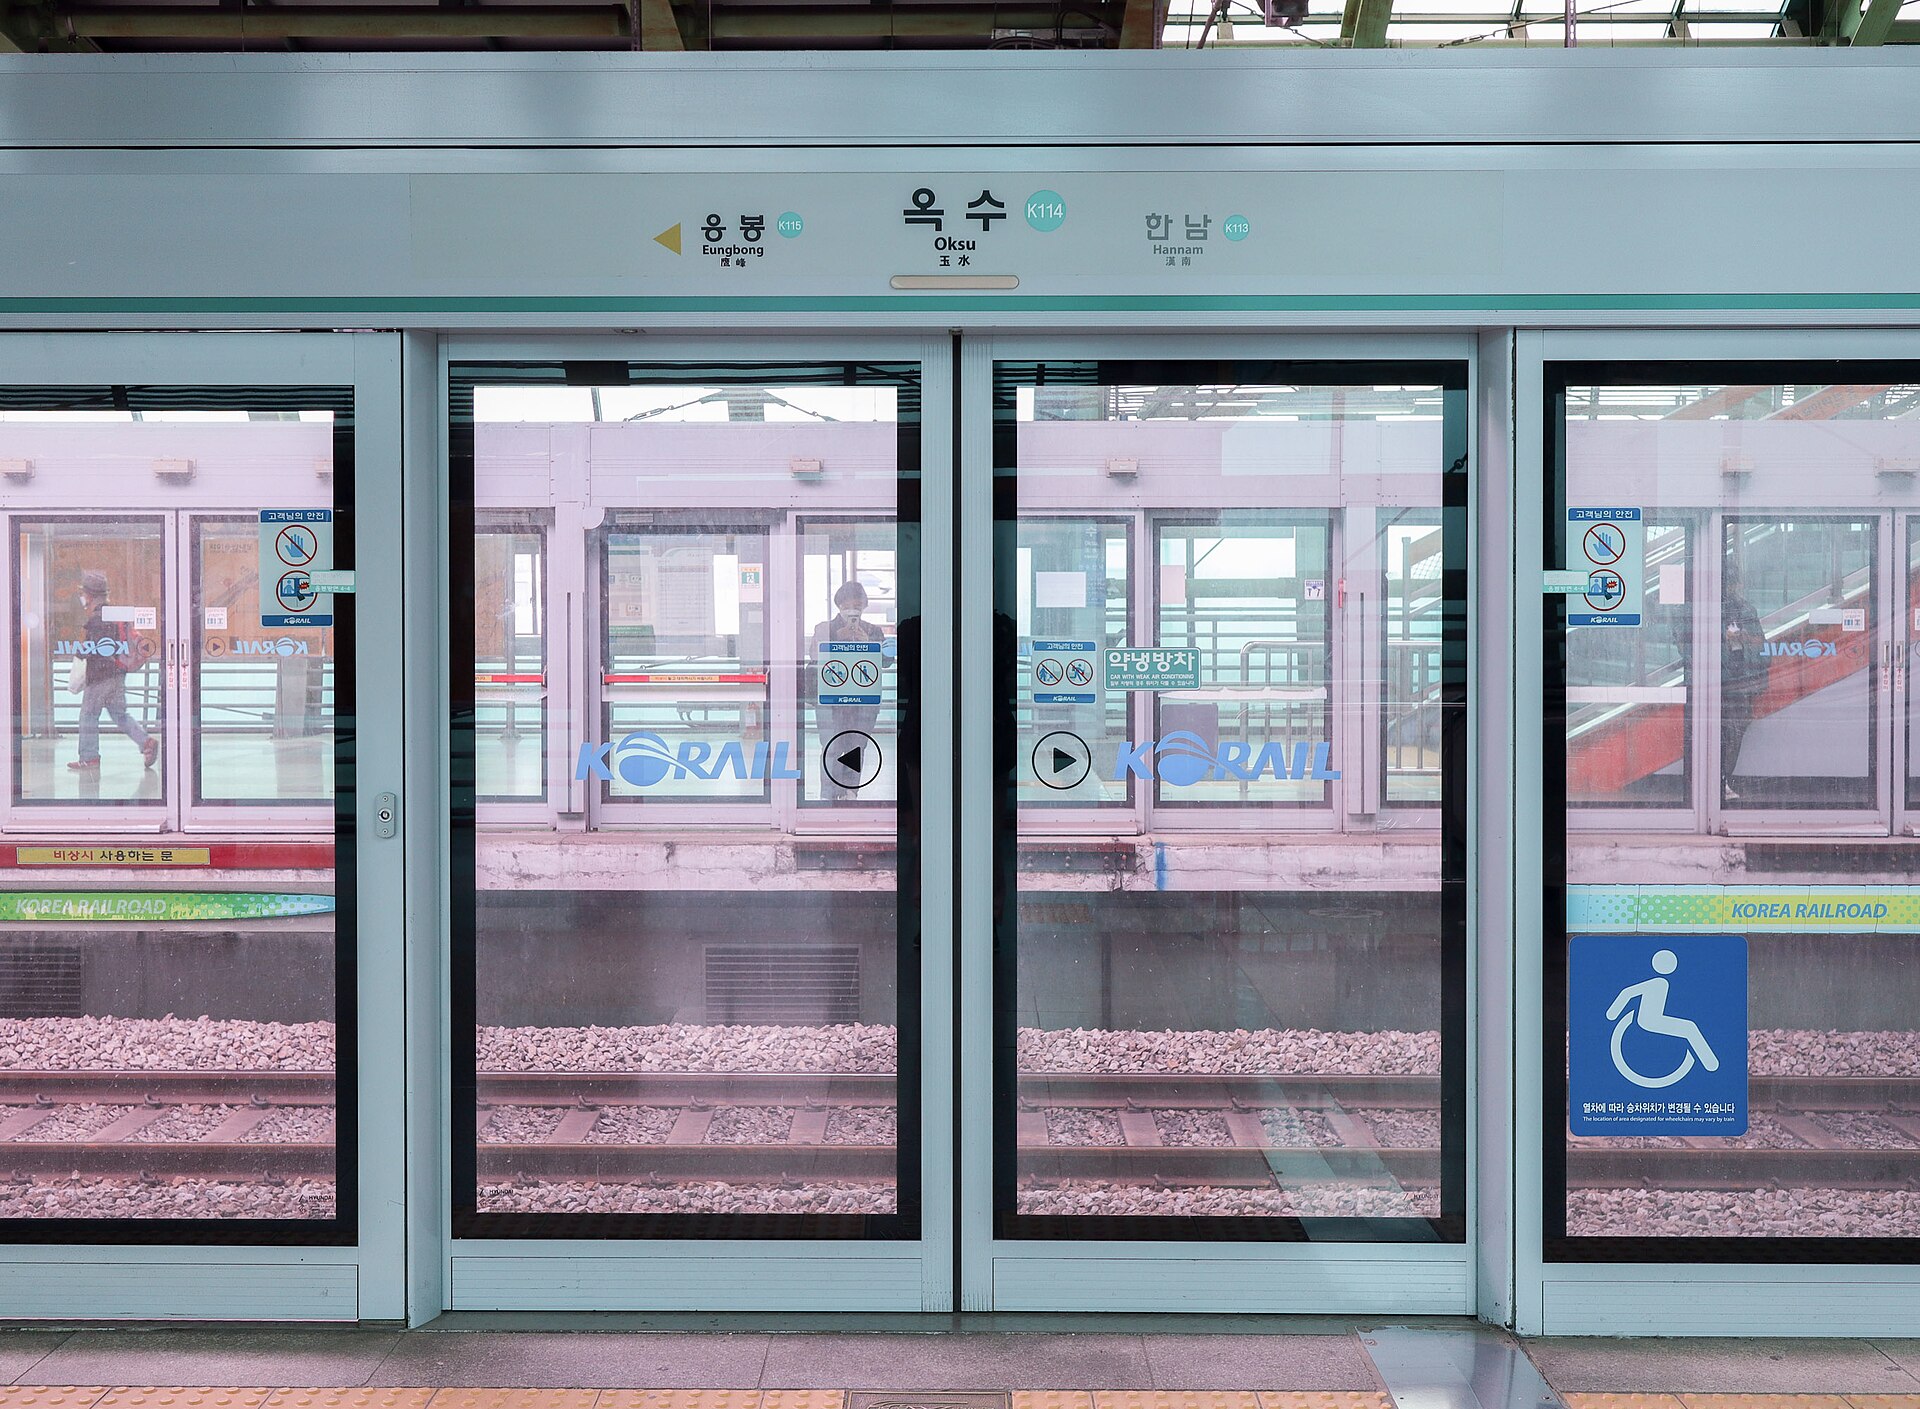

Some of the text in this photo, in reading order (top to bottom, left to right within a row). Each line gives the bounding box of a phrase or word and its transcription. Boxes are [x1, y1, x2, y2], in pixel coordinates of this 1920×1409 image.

[903, 188, 1006, 231] 옥수
[1027, 203, 1063, 218] K114
[701, 213, 765, 242] 응봉
[778, 220, 801, 231] K115
[1145, 213, 1212, 240] 한남
[1225, 223, 1249, 233] K113
[934, 236, 976, 251] Oksu
[1153, 244, 1203, 255] Hannam
[702, 244, 764, 257] Eungbong
[939, 254, 971, 267] 玉水
[1165, 256, 1191, 267] 漢南
[268, 512, 324, 520] 고객님의 안전
[1576, 510, 1633, 519] 고객님의 안전
[284, 616, 311, 625] KORAIL
[1590, 615, 1618, 624] KORAIL
[1109, 652, 1195, 672] 약냉방차
[575, 731, 801, 787] KORAIL
[1114, 730, 1341, 787] KORAIL
[53, 850, 173, 862] 비상시 사용하는 문
[15, 899, 167, 914] KOREA RAILROAD
[1731, 903, 1888, 918] KOREA RAILROAD
[1583, 1102, 1735, 1114] 열차에 따라 승차위치가 변경될 수 있습니다
